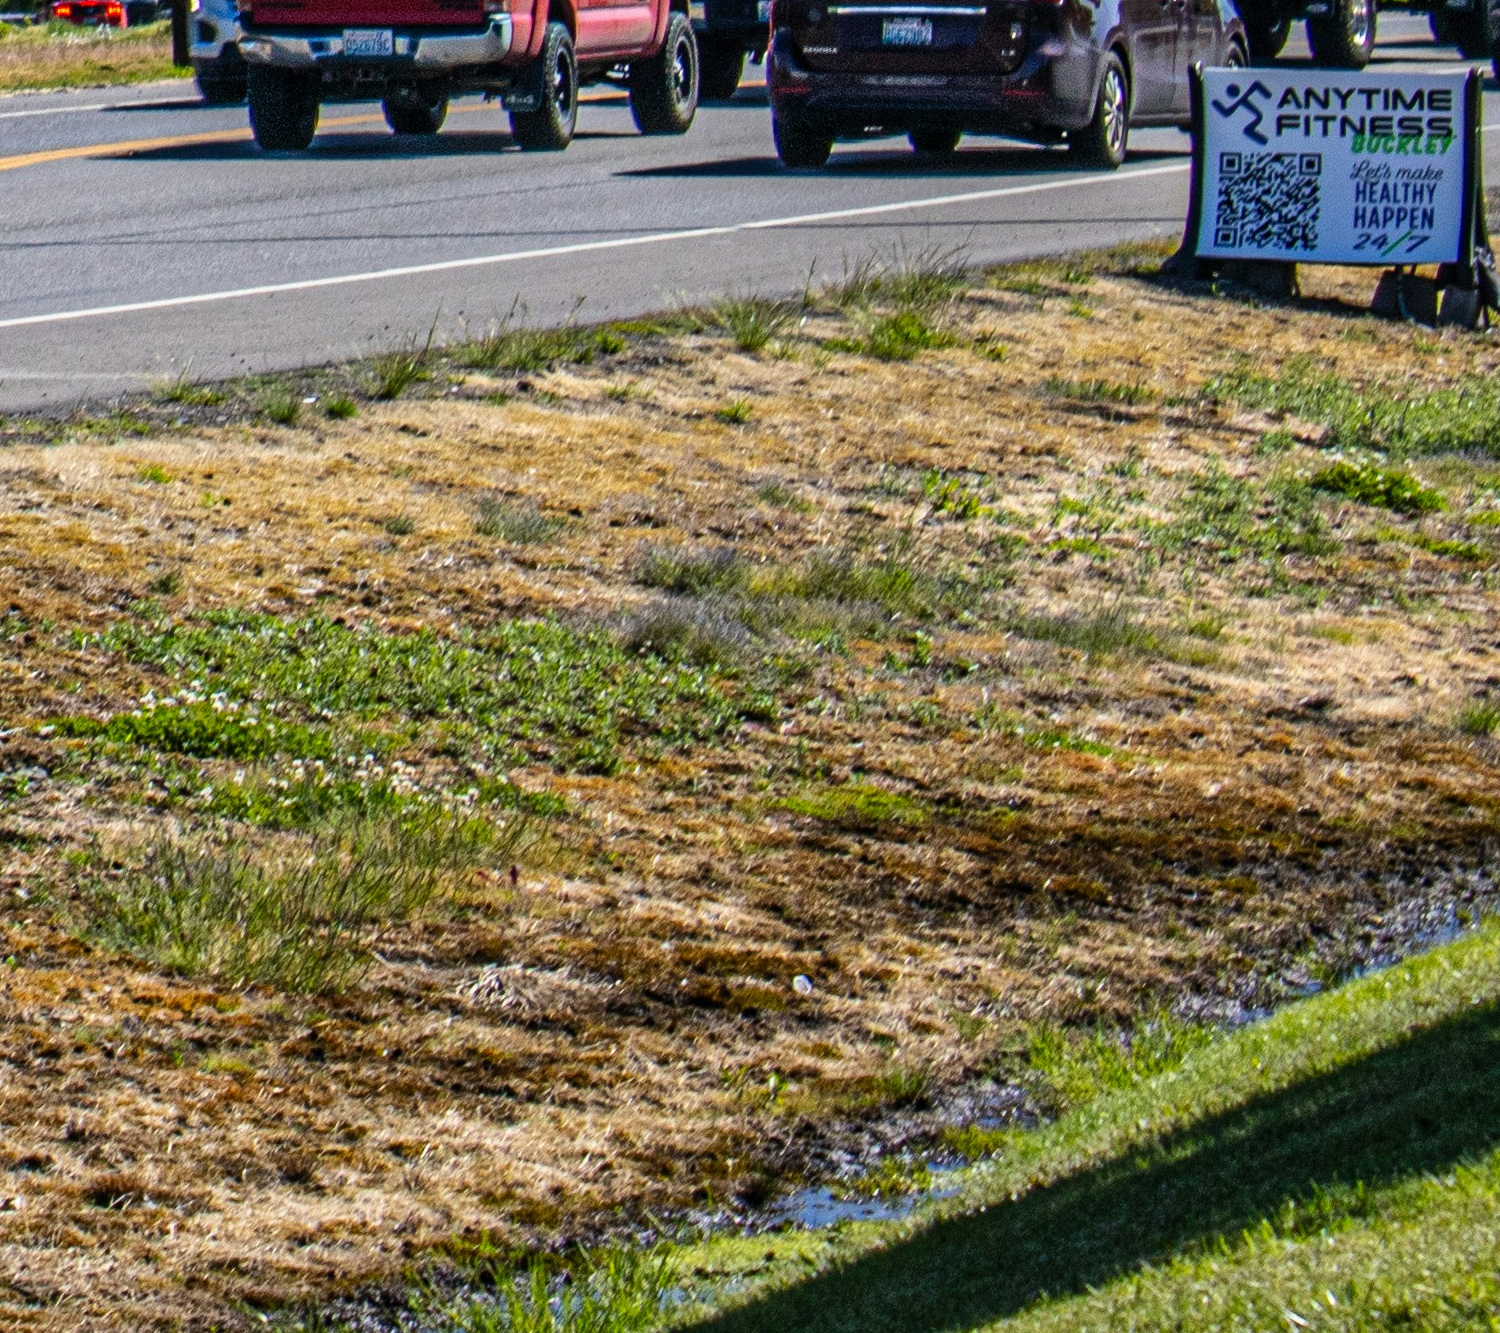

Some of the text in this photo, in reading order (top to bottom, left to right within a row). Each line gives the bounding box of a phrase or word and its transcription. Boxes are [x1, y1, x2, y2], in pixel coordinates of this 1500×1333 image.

[1277, 87, 1452, 112] ANYTIME
[1276, 114, 1453, 138] FITNESS
[1351, 133, 1457, 155] BUCKLEY
[1395, 163, 1445, 181] make
[1355, 181, 1438, 204] HEALTHY
[1353, 205, 1435, 229] HAPPEN
[1352, 229, 1430, 257] 24/7
